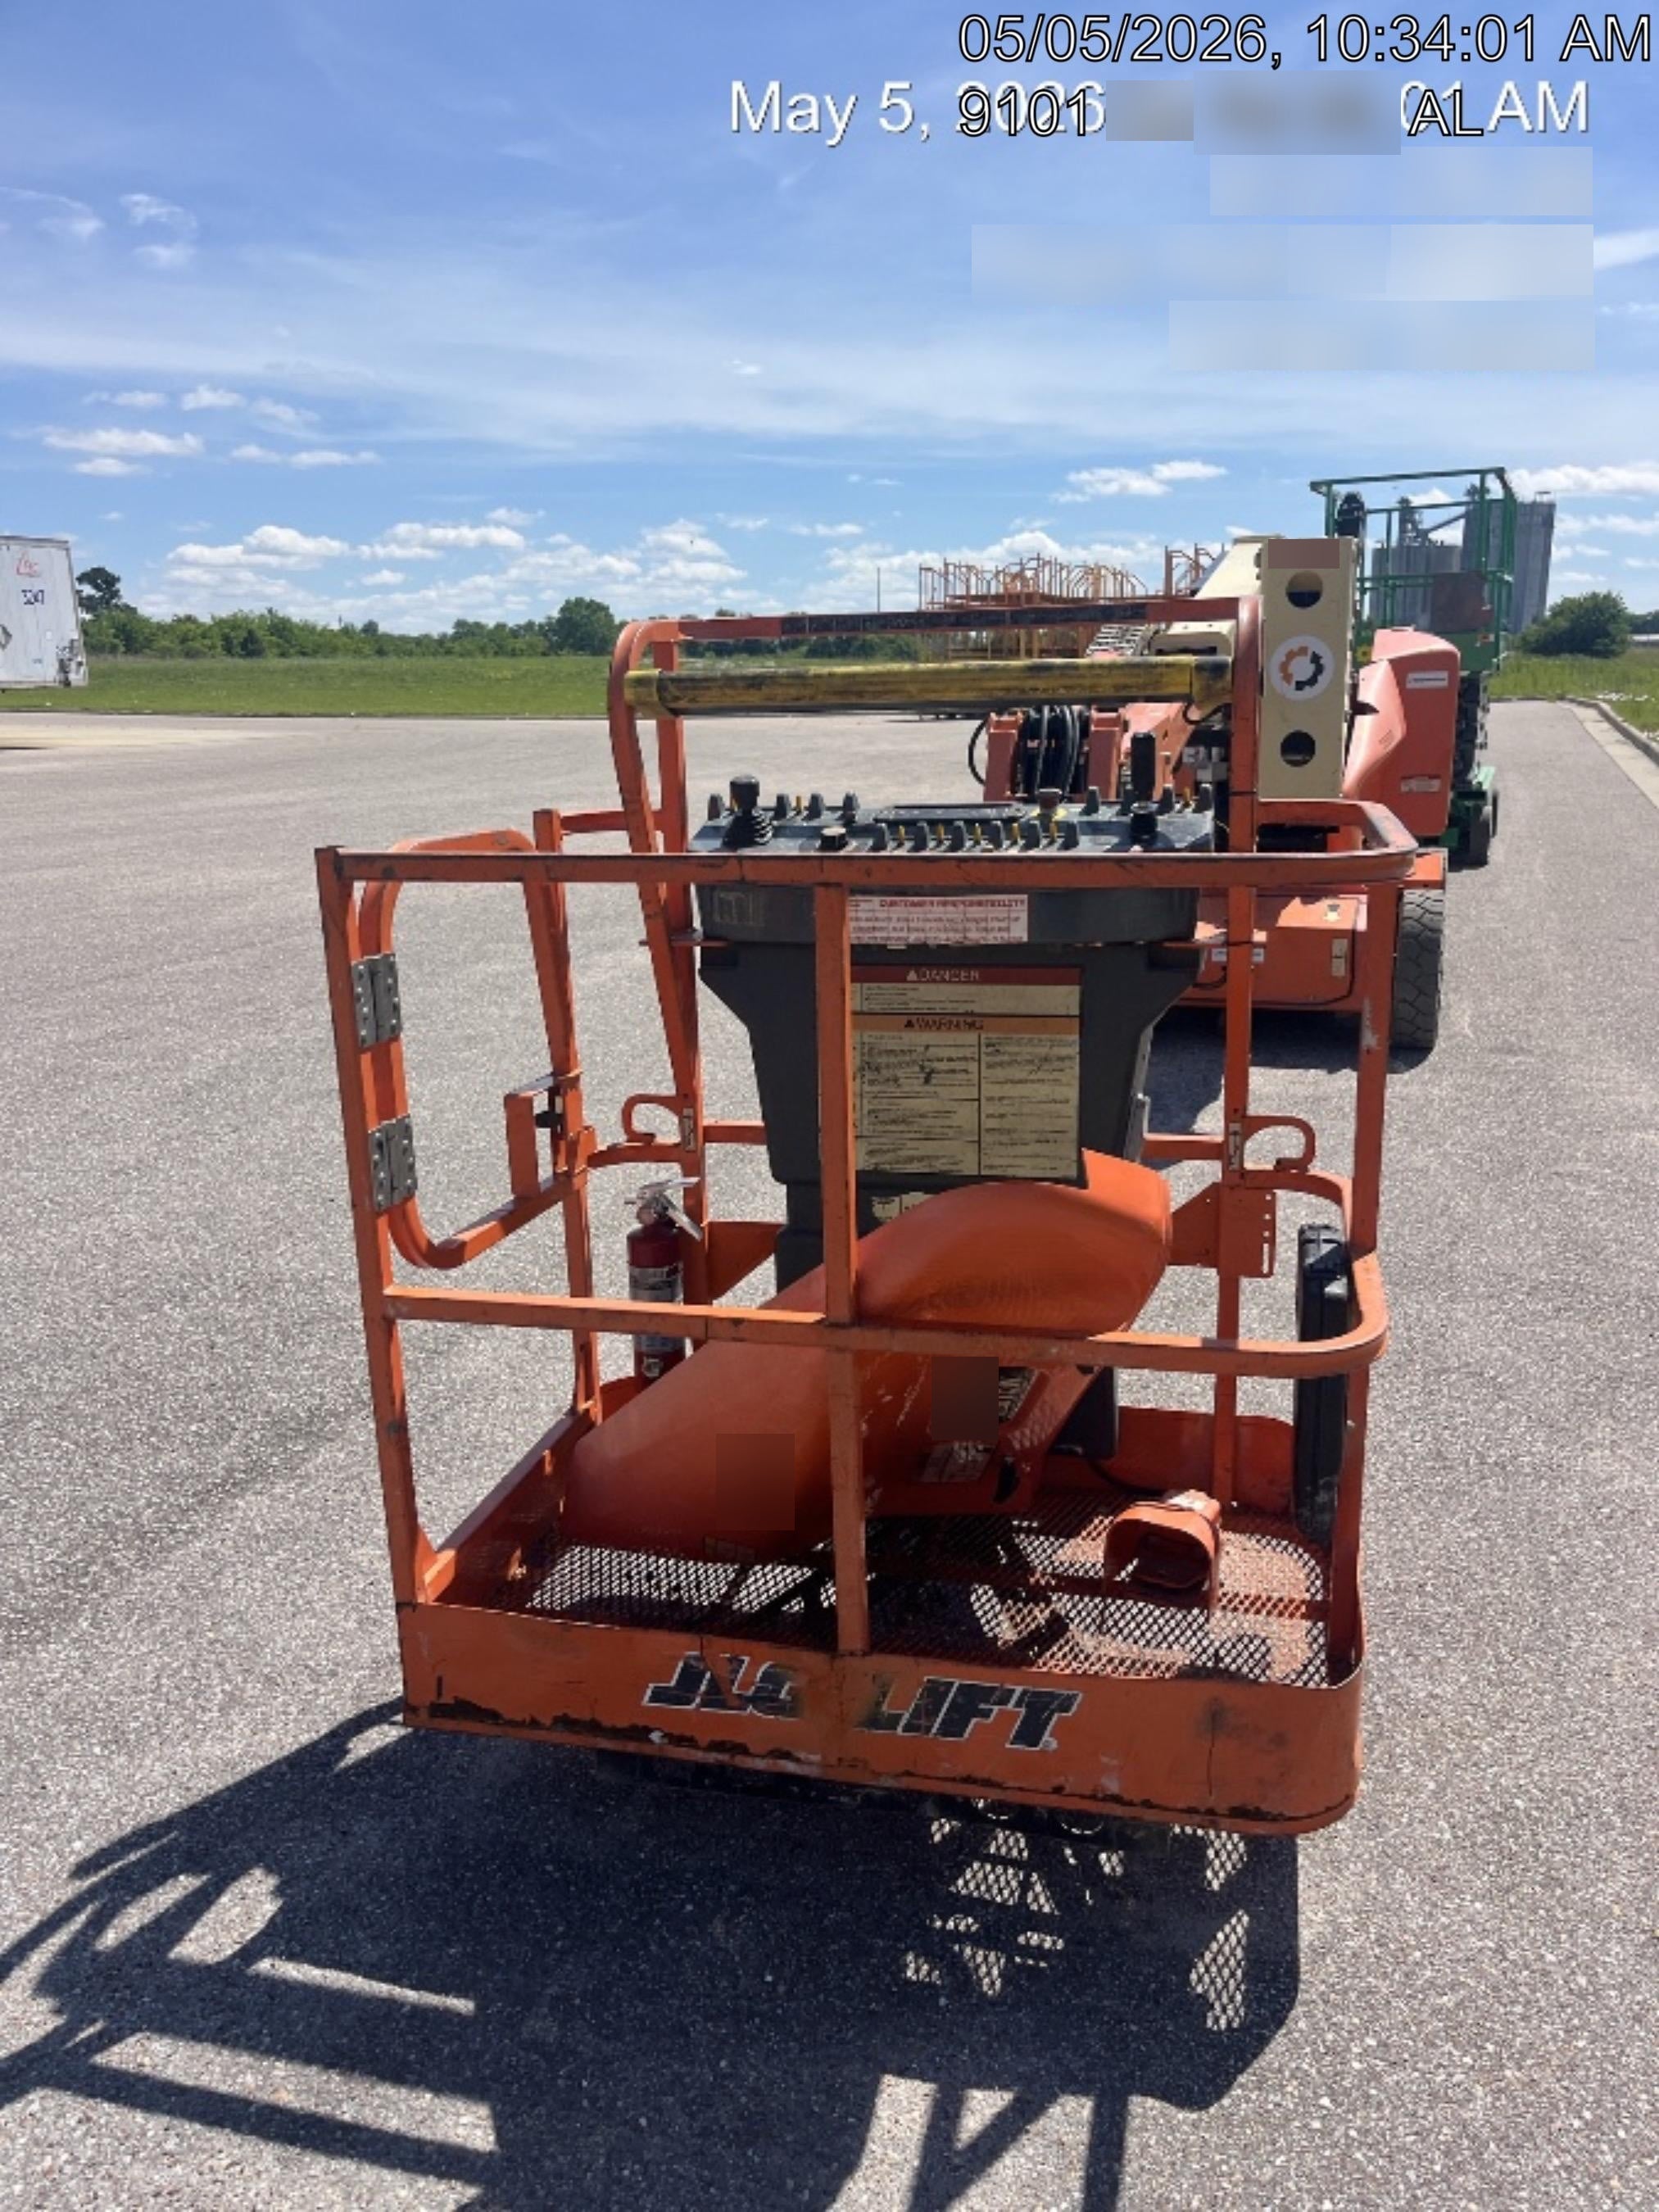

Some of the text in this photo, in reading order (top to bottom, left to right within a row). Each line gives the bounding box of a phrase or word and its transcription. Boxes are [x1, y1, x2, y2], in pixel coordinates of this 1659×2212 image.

[918, 968, 979, 982] DANGER
[916, 1017, 983, 1031] WARNING
[856, 1673, 1082, 1751] LIFT
